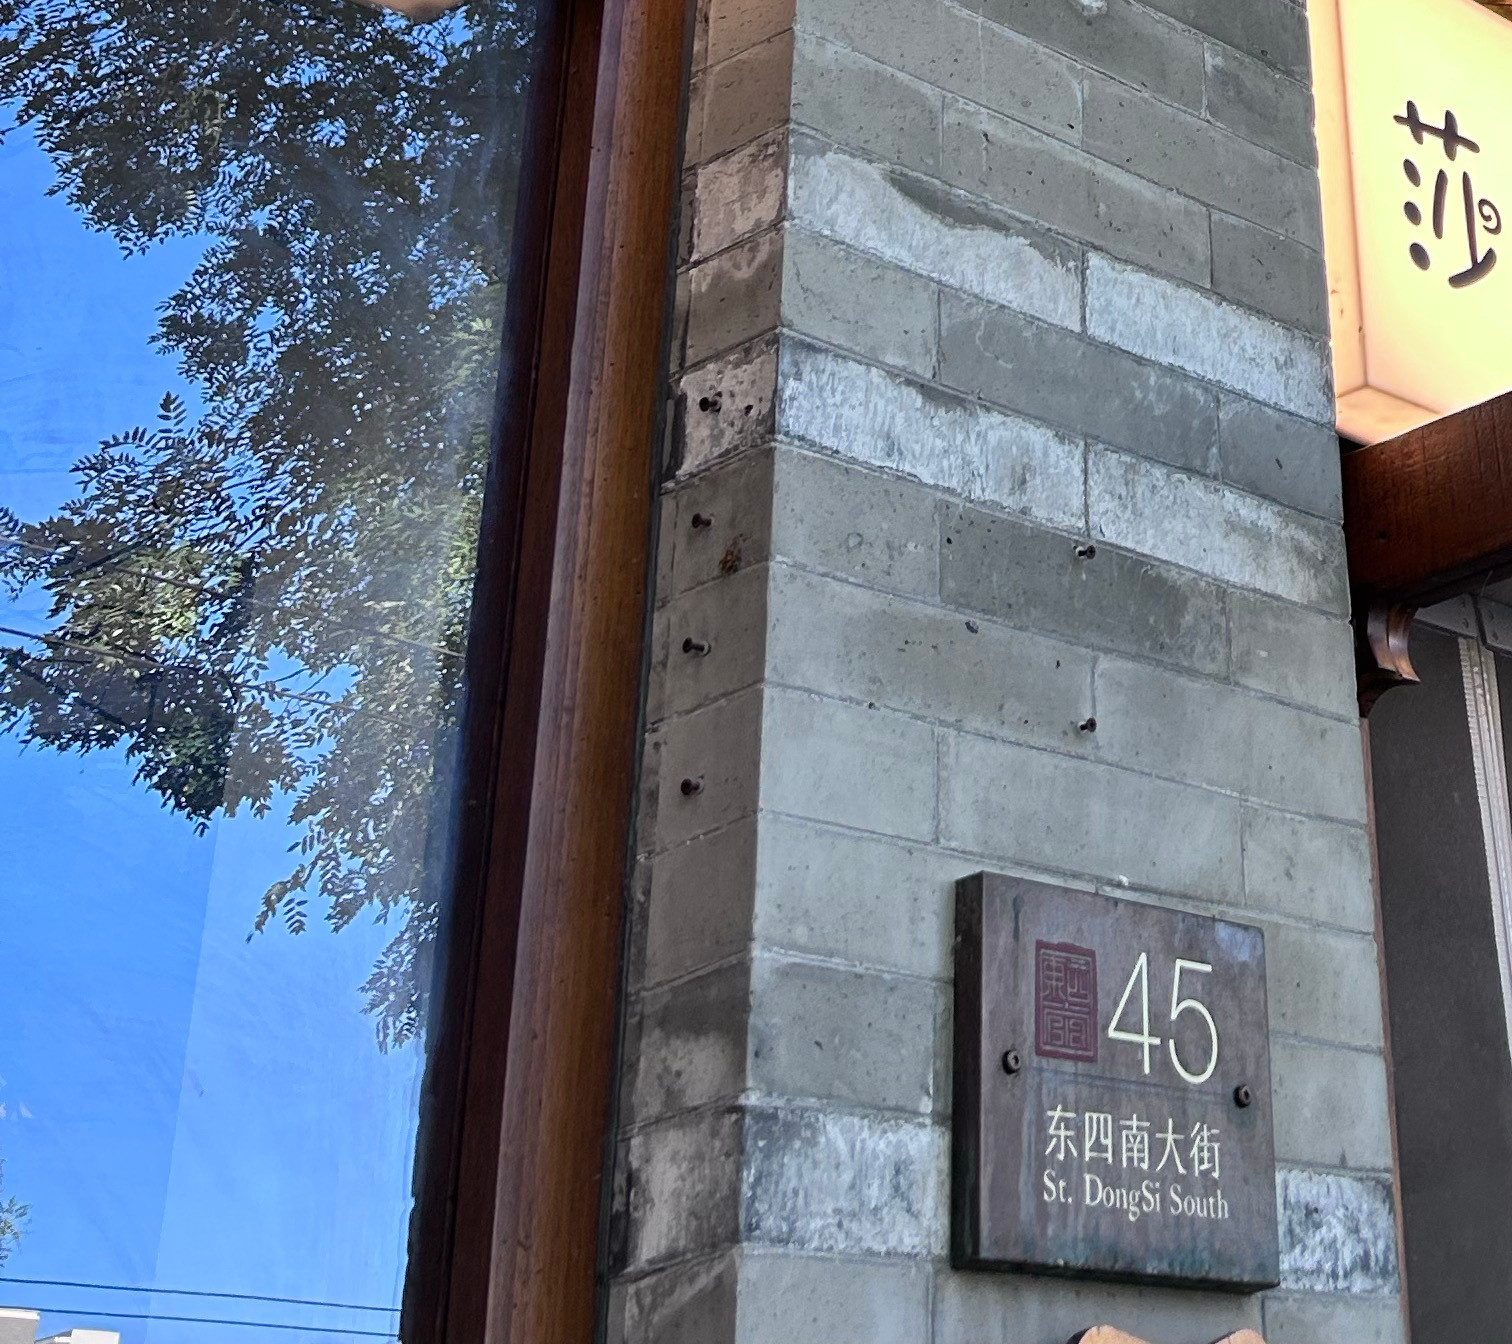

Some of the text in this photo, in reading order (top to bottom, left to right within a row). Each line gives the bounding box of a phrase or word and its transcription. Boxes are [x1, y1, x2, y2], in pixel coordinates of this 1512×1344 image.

[1108, 952, 1219, 1085] 45
[1045, 1104, 1220, 1179] 东四南大街
[1043, 1168, 1229, 1222] St. DongSi South
